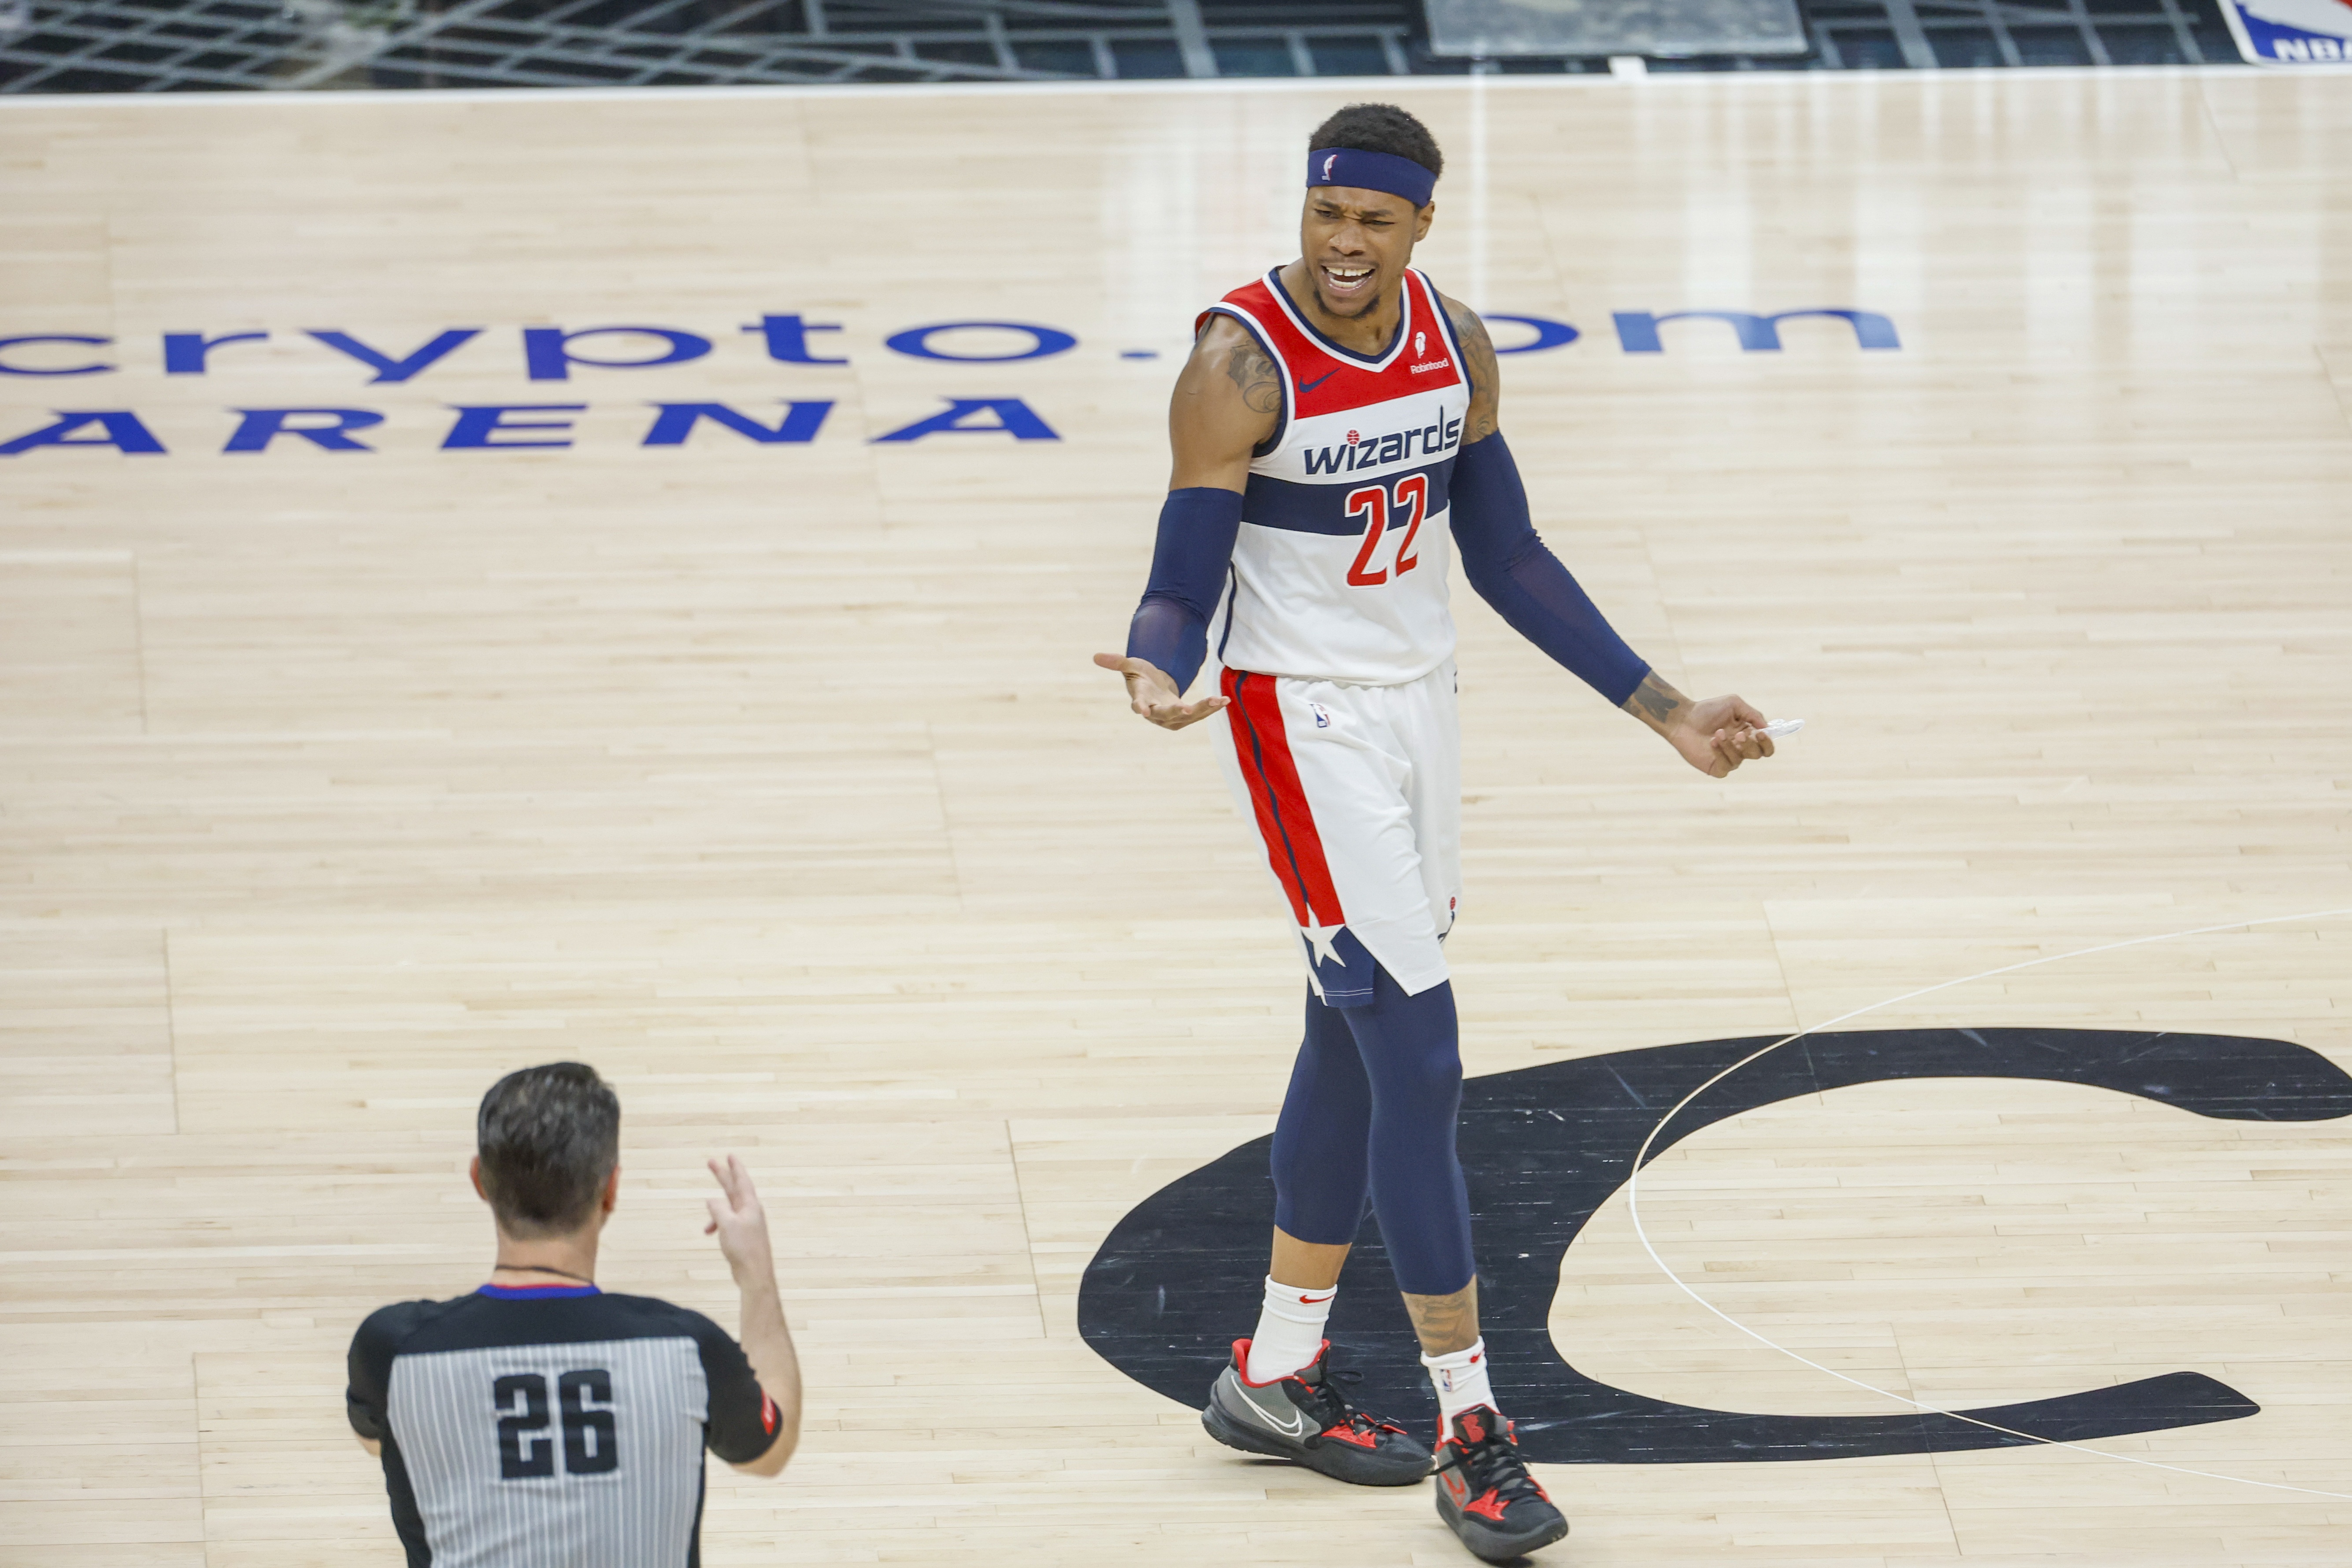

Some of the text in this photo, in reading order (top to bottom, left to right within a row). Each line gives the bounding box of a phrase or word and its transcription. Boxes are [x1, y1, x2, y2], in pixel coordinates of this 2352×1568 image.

[2273, 38, 2352, 62] NB
[0, 308, 1902, 385] crypto.om
[1410, 357, 1449, 374] Robinhood
[0, 396, 1063, 454] ARENA
[1304, 404, 1462, 476] wizards
[1345, 473, 1429, 589] 22
[493, 1369, 619, 1480] 26
